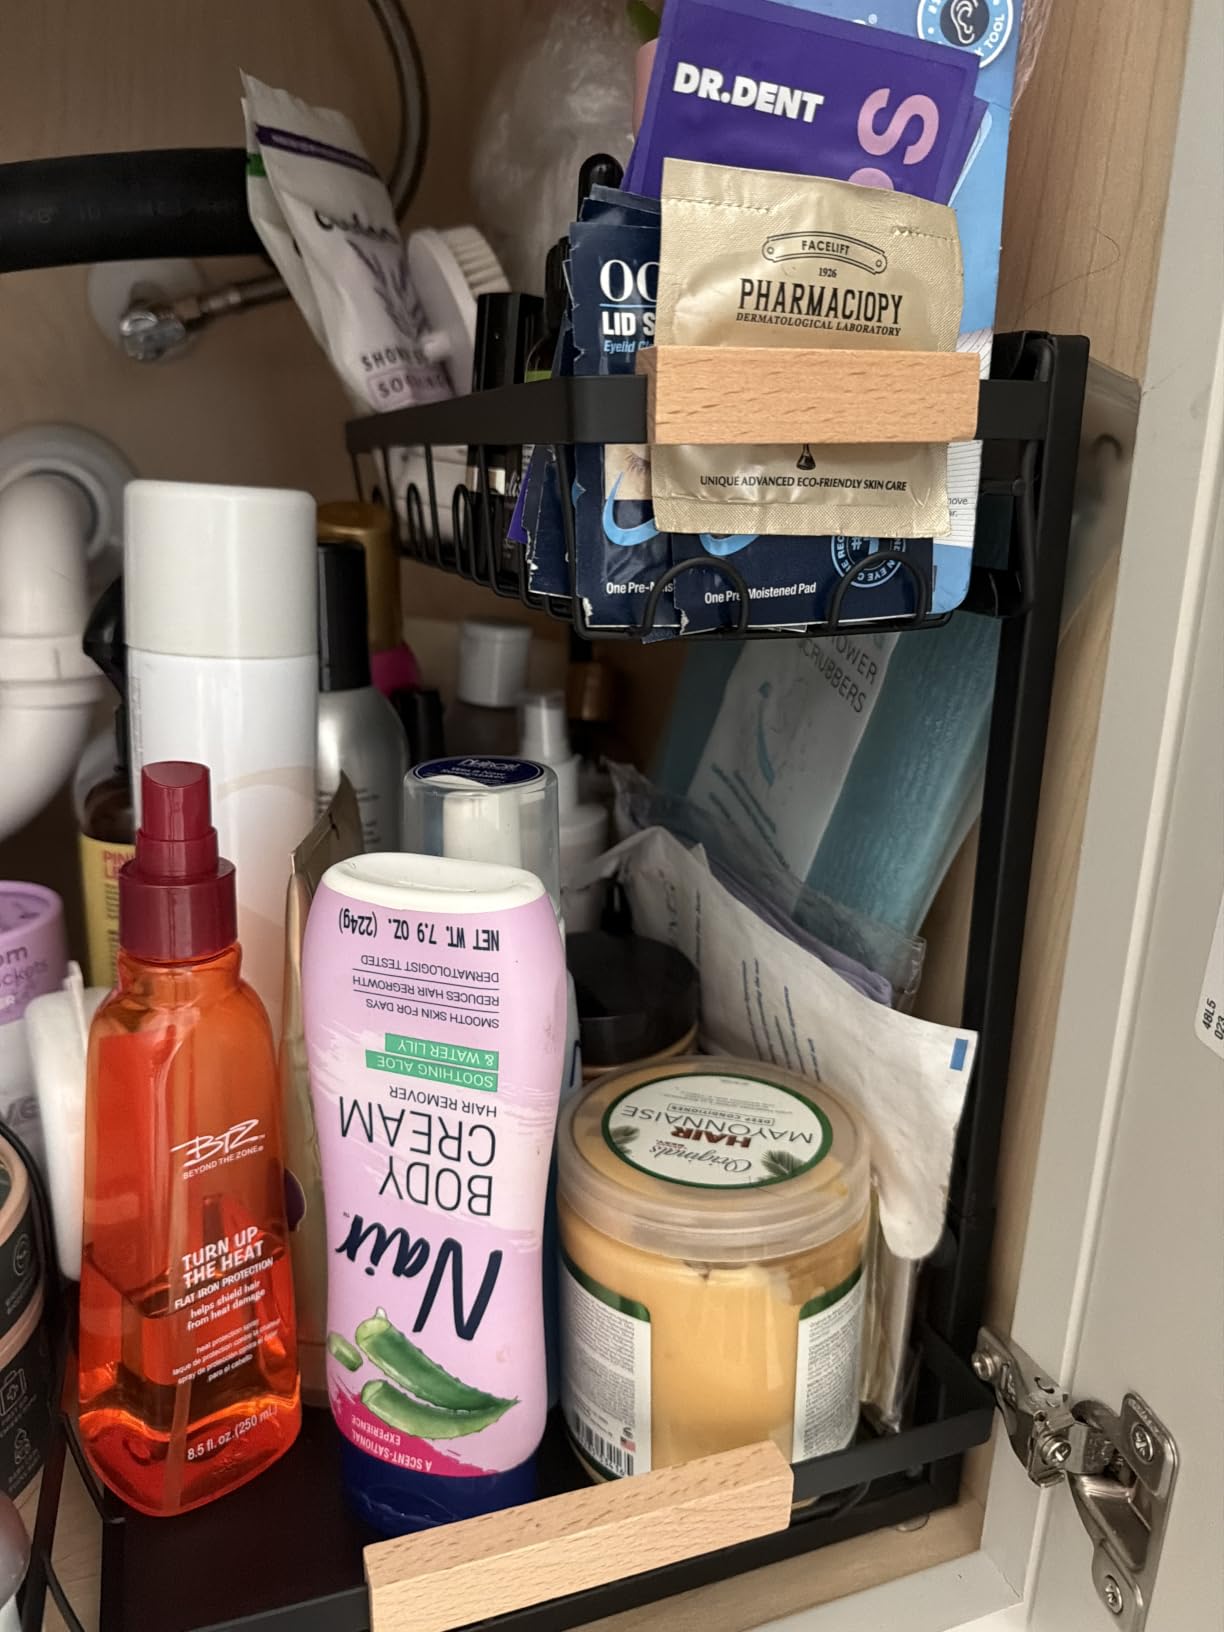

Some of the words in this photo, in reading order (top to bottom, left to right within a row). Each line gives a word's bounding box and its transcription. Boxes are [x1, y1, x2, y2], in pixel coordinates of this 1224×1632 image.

[984, 14, 1005, 49] TOOL
[673, 62, 825, 123] DR.DENT
[801, 240, 850, 256] FACELIFT
[819, 267, 837, 278] 1926
[738, 278, 903, 325] PHARMACIOPY
[602, 311, 636, 336] LID
[736, 312, 833, 330] DERMATOLOGICAL
[835, 322, 902, 337] LABORATORY
[603, 340, 636, 354] Eyelid
[700, 476, 740, 487] UNIQUE
[741, 475, 795, 487] ADVANCED
[797, 477, 863, 489] ECO-FRIENDLY
[863, 479, 885, 490] SKIN
[885, 480, 907, 491] CARE
[606, 582, 626, 594] One
[705, 592, 725, 604] One
[798, 582, 817, 594] Pad
[832, 635, 878, 685] OWER
[801, 638, 866, 713] CRUBBERS
[338, 907, 378, 938] (224g)
[388, 918, 410, 941] OZ.
[417, 922, 437, 945] 7.9
[446, 926, 466, 949] WT.
[472, 929, 500, 951] NET
[360, 954, 401, 971] TESTED
[404, 961, 499, 983] DERMATOLOGIST
[352, 975, 415, 996] REGROWTH
[417, 985, 444, 999] HAIR
[366, 998, 394, 1012] DAYS
[446, 990, 499, 1006] REDUCES
[396, 1004, 418, 1017] FOR
[421, 1008, 447, 1021] SKIN
[450, 1013, 499, 1029] SMOOTH
[398, 1039, 426, 1052] LILY
[430, 1045, 480, 1065] WATER
[377, 1055, 413, 1072] ALOE
[484, 1054, 495, 1067] &
[418, 1062, 494, 1088] SOOTHING
[389, 1085, 458, 1111] REMOVER
[462, 1101, 497, 1118] HAIR
[338, 1096, 496, 1167] CREAM
[621, 1105, 813, 1144] MAYONNAISE
[671, 1125, 751, 1148] HAIR
[183, 1160, 218, 1179] BEYOND
[219, 1153, 234, 1165] THE
[649, 1144, 752, 1173] Originals
[379, 1155, 493, 1217] BODY
[182, 1237, 230, 1271] TURN
[234, 1226, 258, 1248] UP
[183, 1260, 216, 1288] THE
[222, 1240, 264, 1272] HEAT
[174, 1293, 195, 1309] FLAT
[197, 1281, 220, 1298] IRON
[222, 1257, 274, 1287] PROTECTION
[335, 1214, 503, 1341] Nair
[187, 1315, 209, 1330] from
[211, 1305, 230, 1319] heat
[232, 1289, 266, 1309] damage
[191, 1301, 215, 1318] helps
[217, 1287, 242, 1306] shield
[244, 1280, 261, 1294] hair
[351, 1414, 401, 1446] EXPERIENCE
[187, 1443, 205, 1460] 8.5
[206, 1438, 217, 1451] fl.
[351, 1428, 423, 1472] SCENT-SATIONAL
[425, 1460, 433, 1472] A
